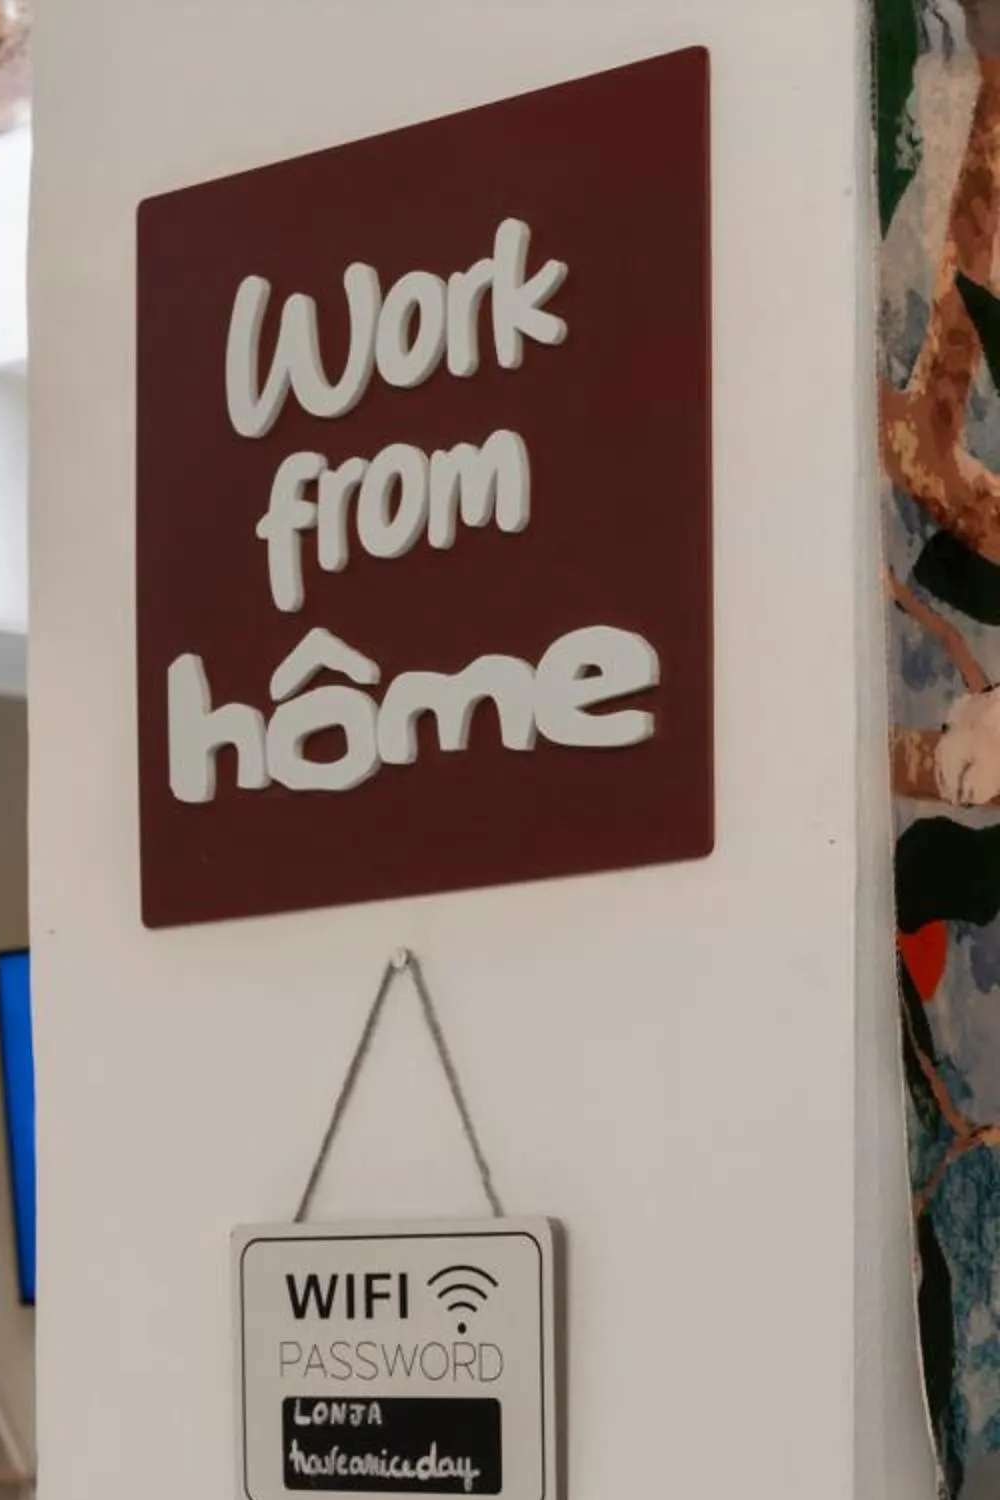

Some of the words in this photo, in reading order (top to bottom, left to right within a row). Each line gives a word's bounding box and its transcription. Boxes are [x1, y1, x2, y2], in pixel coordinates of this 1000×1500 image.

[224, 217, 568, 439] Work
[256, 429, 531, 612] from
[168, 626, 660, 803] hôme
[285, 1273, 409, 1320] WIFI
[279, 1341, 504, 1383] PASSWORD
[293, 1397, 382, 1426] LONJA
